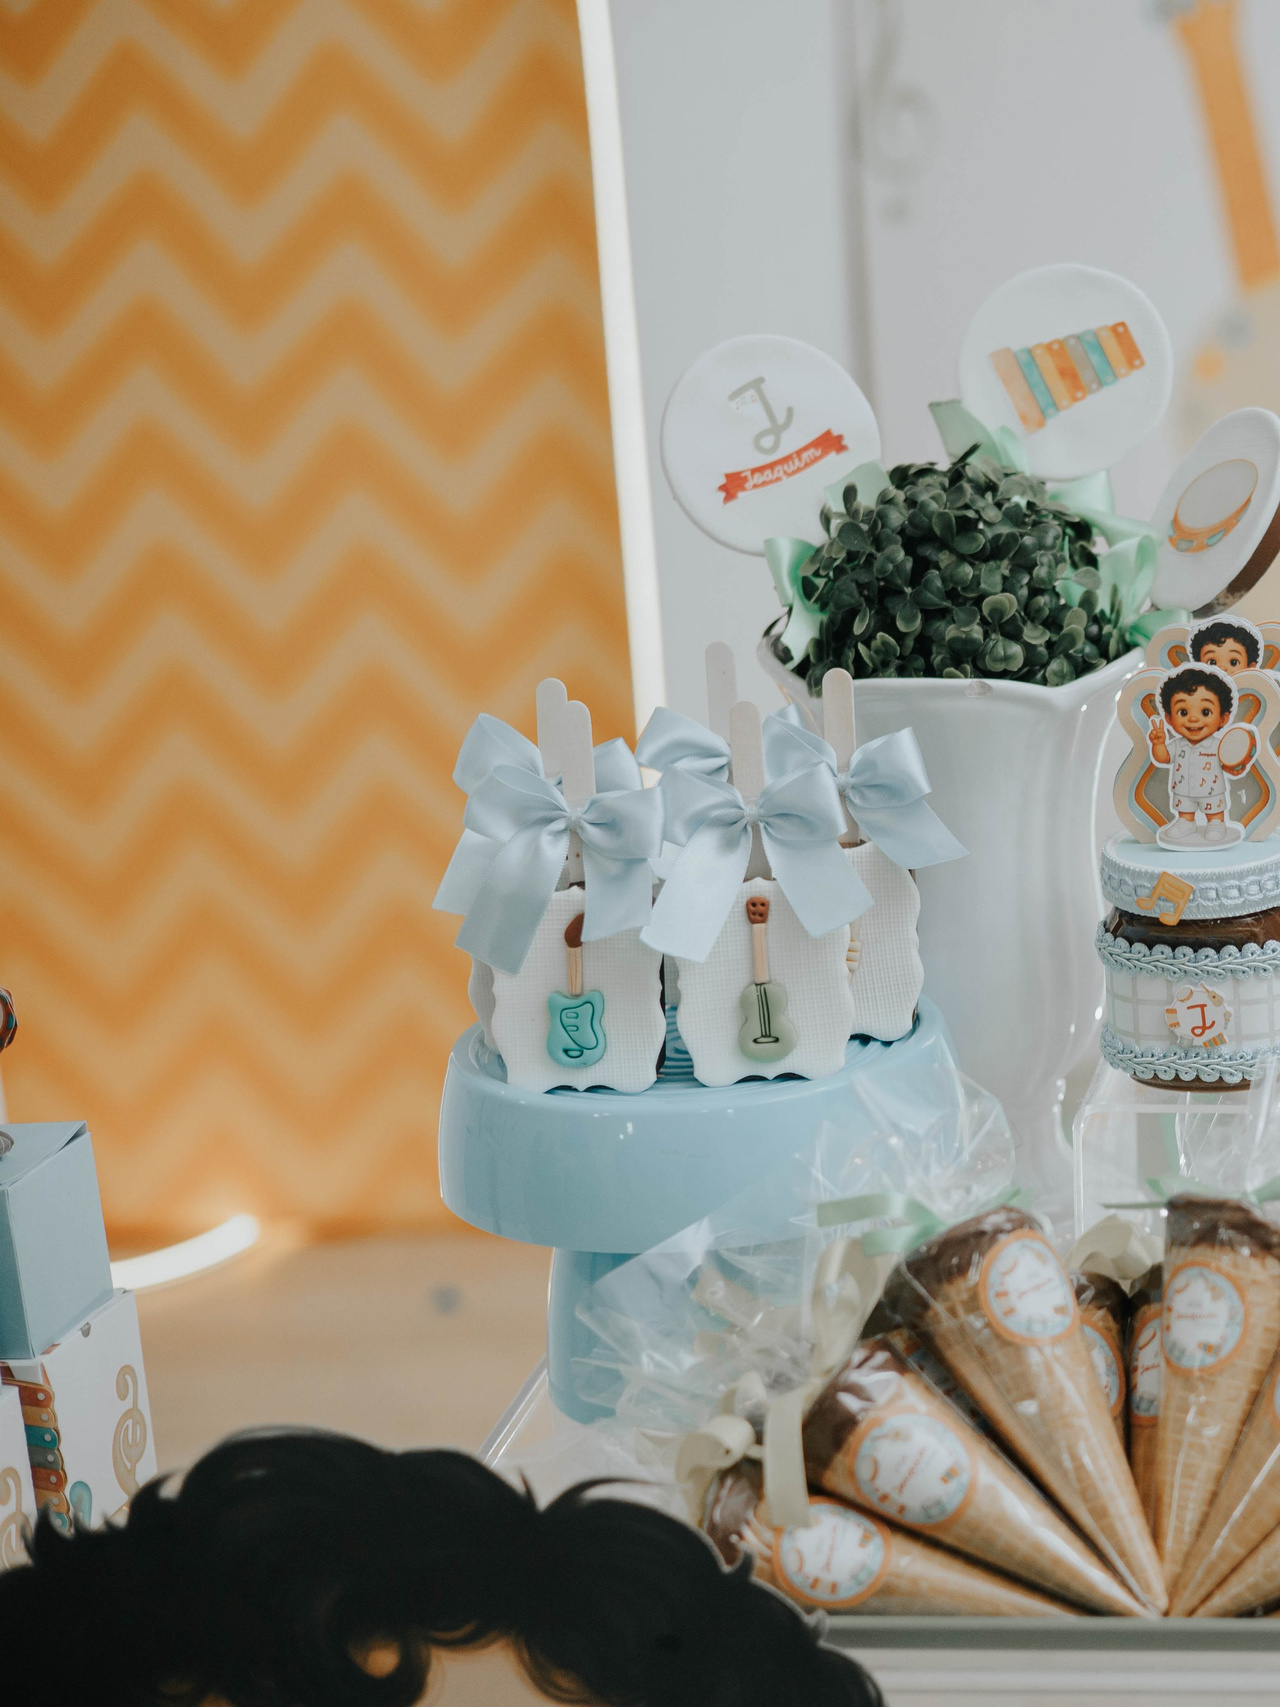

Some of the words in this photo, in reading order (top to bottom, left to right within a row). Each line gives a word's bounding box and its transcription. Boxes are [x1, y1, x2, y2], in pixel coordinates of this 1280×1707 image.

[727, 376, 794, 456] J
[741, 446, 822, 490] Joaquim
[1186, 1003, 1216, 1038] J
